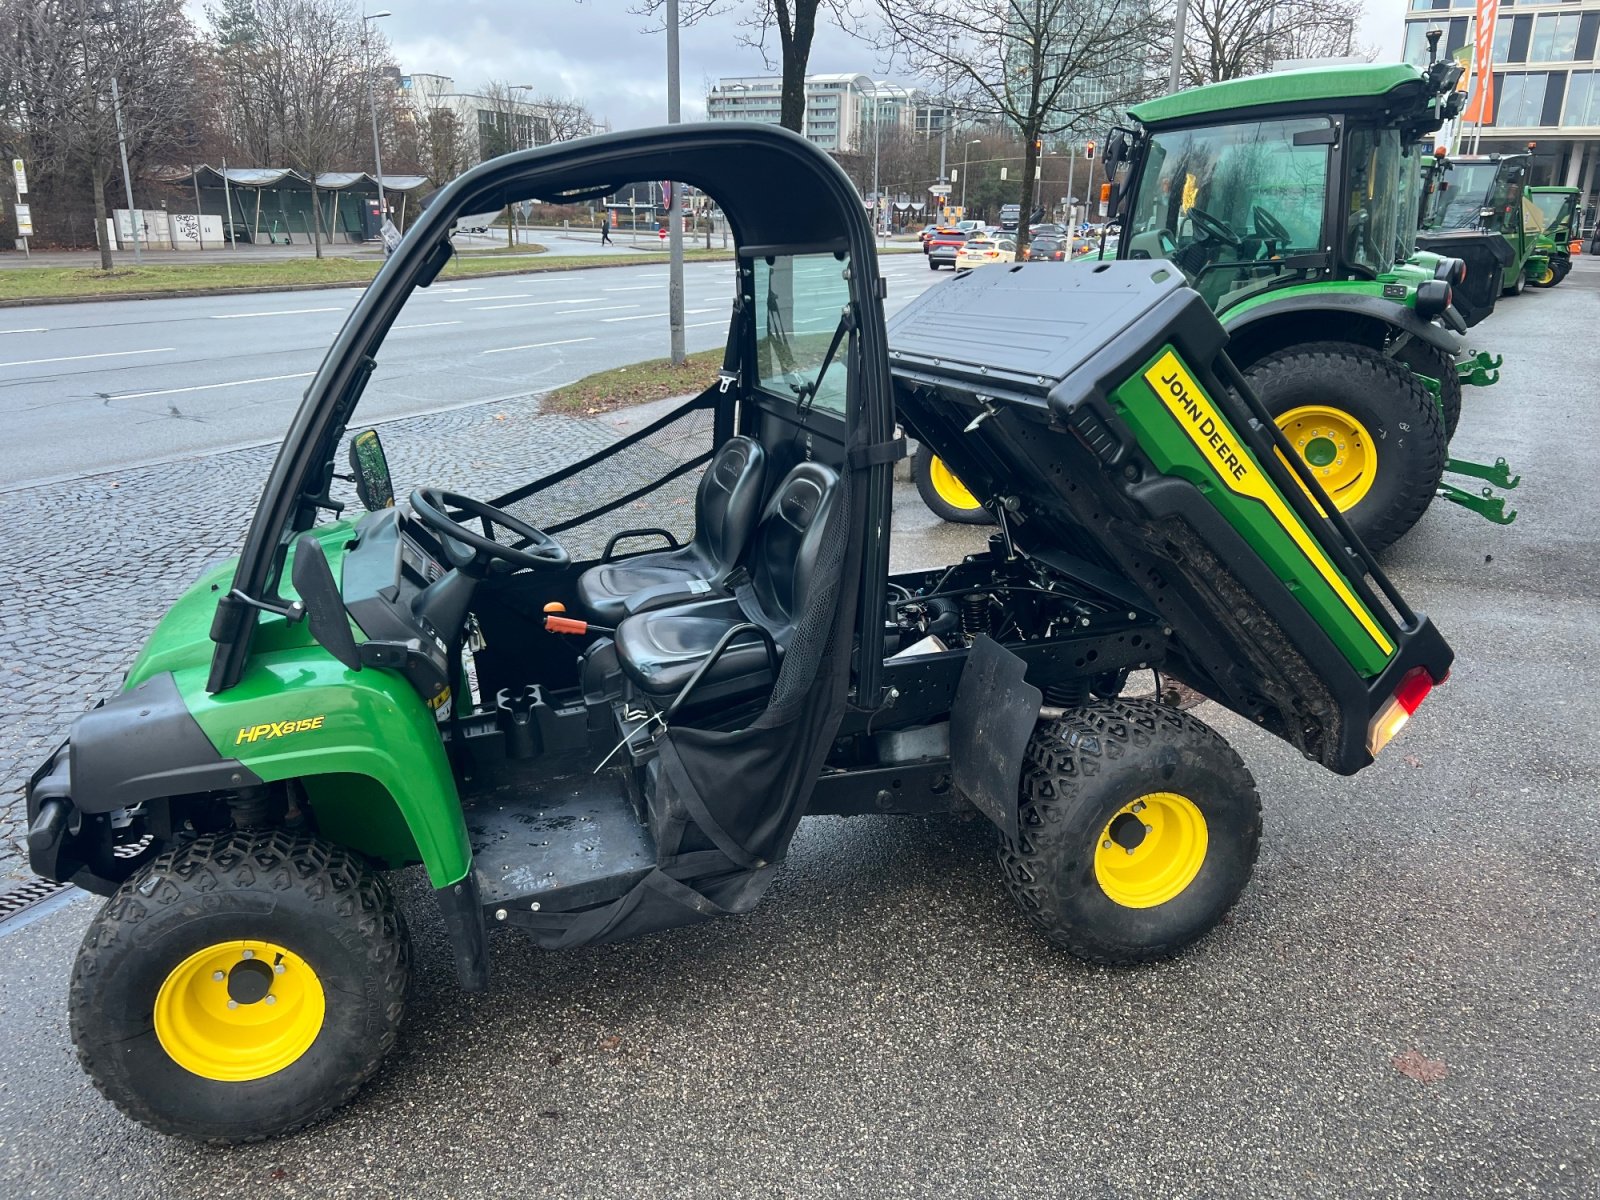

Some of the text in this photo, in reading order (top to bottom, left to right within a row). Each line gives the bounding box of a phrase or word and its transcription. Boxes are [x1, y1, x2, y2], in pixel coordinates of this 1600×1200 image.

[1161, 373, 1247, 481] JOHN DEERE
[235, 715, 325, 745] HPX815E
